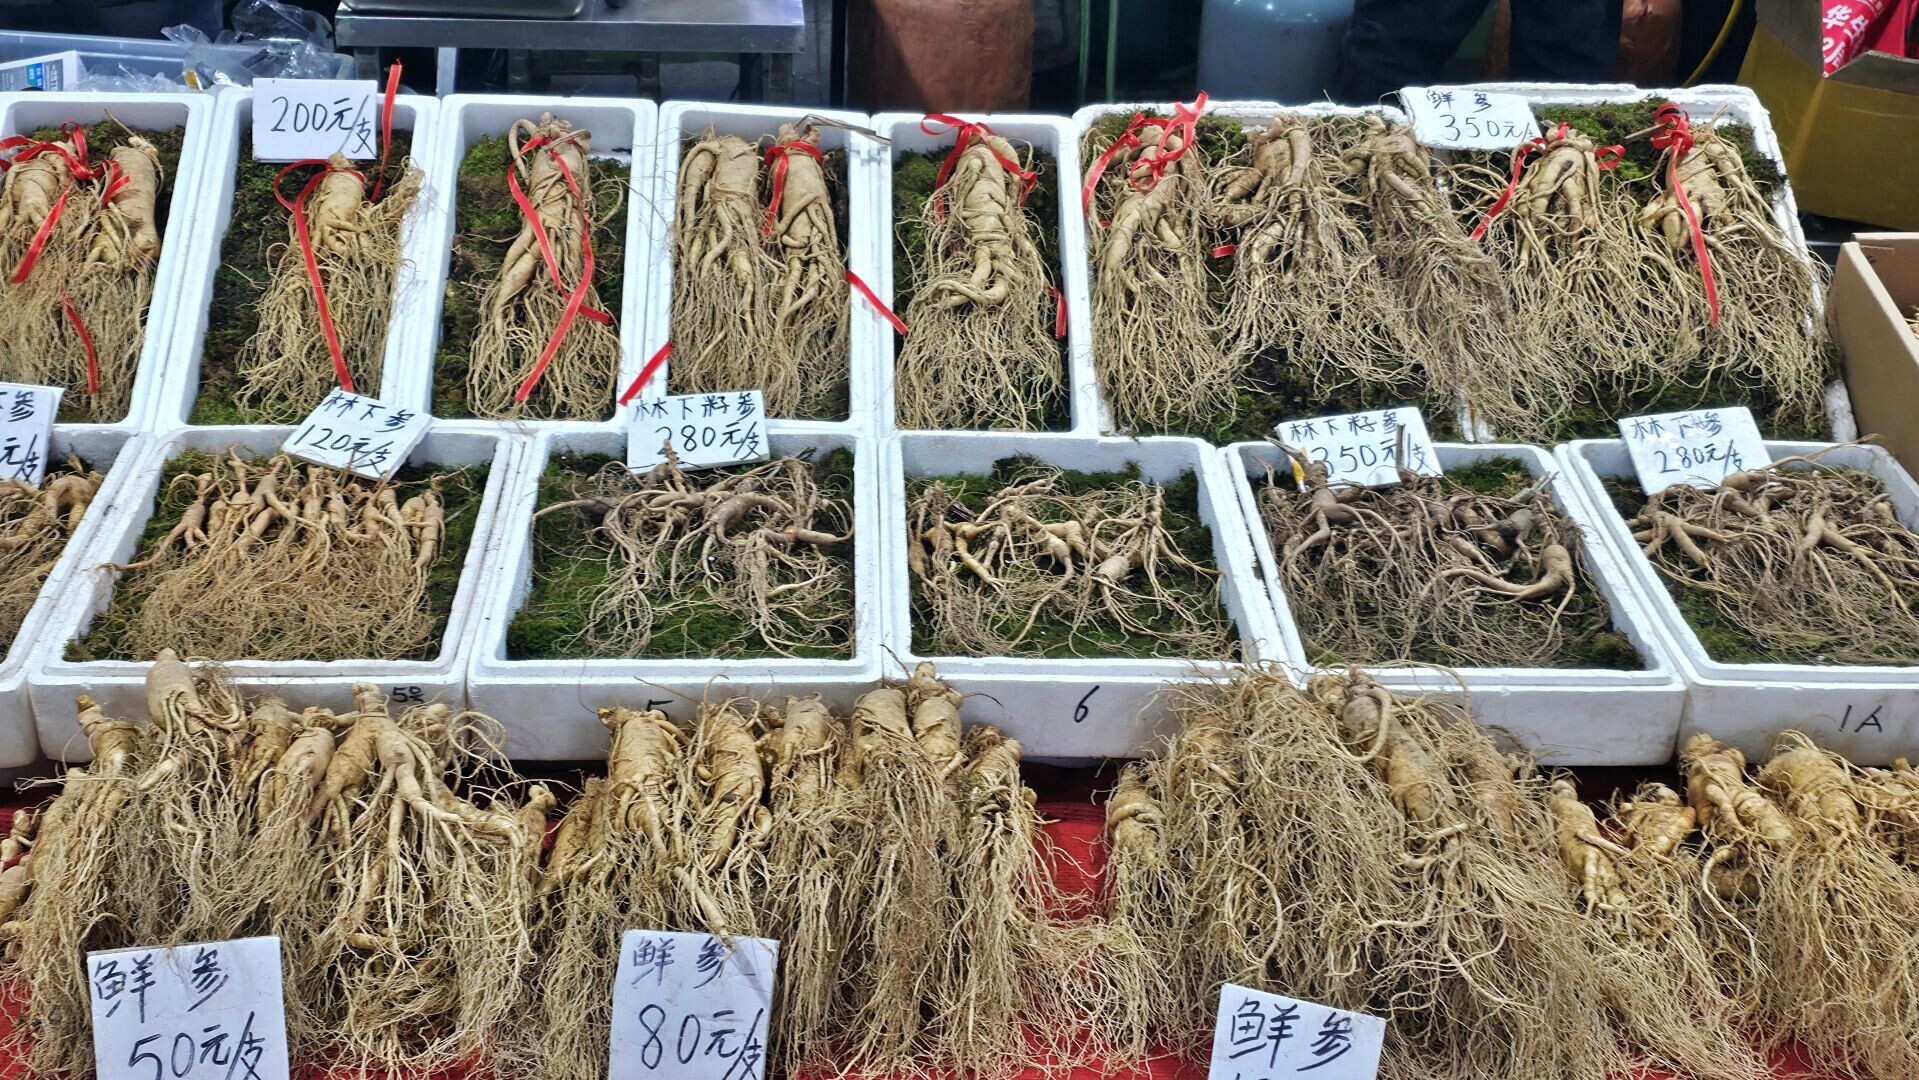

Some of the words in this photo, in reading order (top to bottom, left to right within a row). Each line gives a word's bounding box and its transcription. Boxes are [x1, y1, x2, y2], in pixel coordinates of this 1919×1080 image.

[1426, 89, 1492, 113] 鲜参
[270, 94, 377, 159] 200元/支
[322, 393, 415, 432] 林下参
[633, 392, 756, 422] 林下籽参
[1289, 411, 1398, 441] 林下籽参
[293, 424, 394, 476] 120元/支
[655, 421, 761, 460] 280元/支
[1310, 433, 1442, 478] 350元/支
[1654, 439, 1745, 474] 280元/支
[1074, 685, 1100, 723] 6
[631, 936, 725, 989] 鲜参
[94, 947, 229, 1024] 鲜参
[639, 1003, 764, 1080] 80元/支
[1229, 997, 1352, 1072] 鲜参
